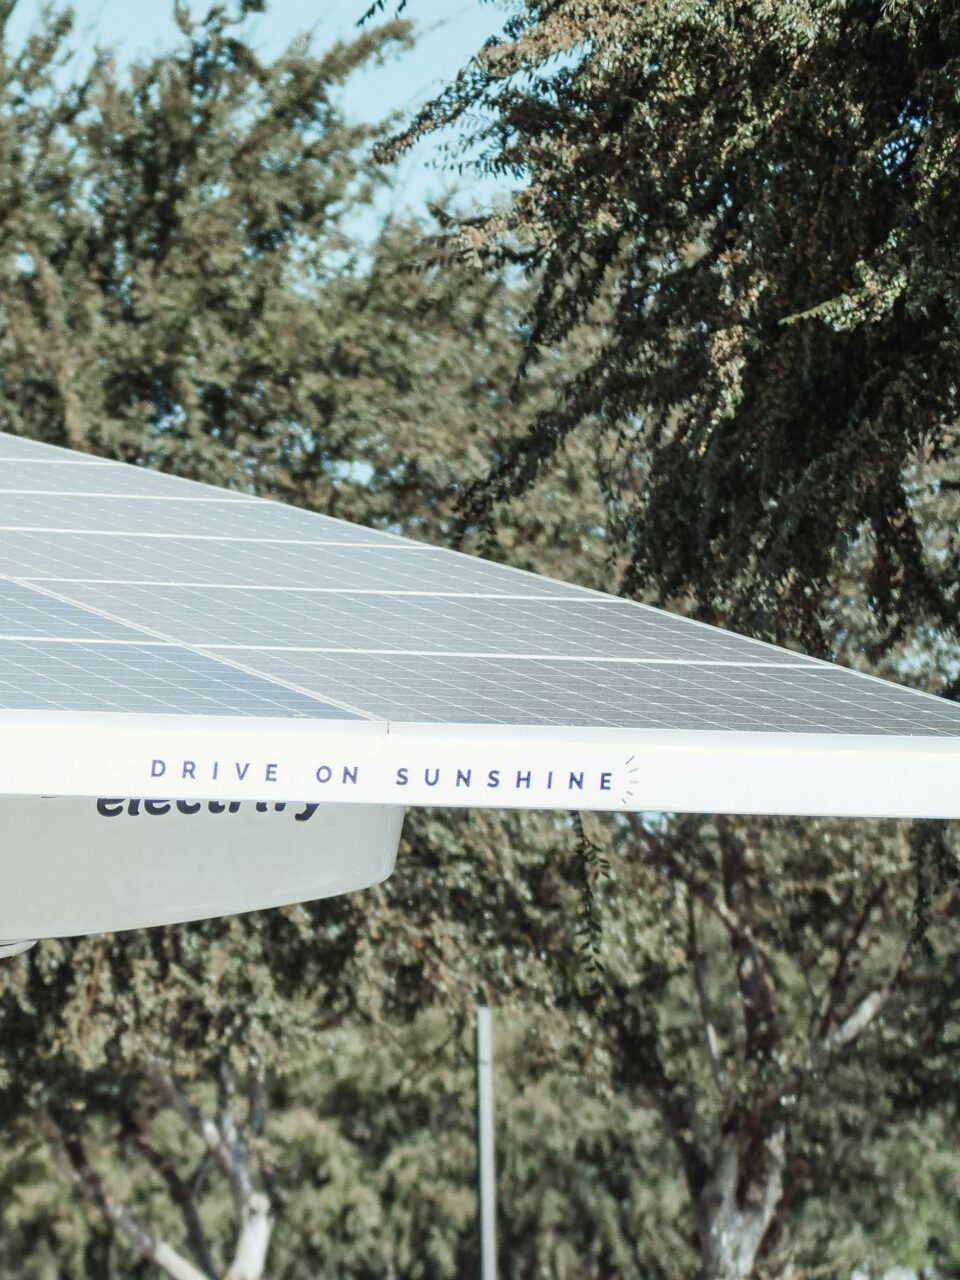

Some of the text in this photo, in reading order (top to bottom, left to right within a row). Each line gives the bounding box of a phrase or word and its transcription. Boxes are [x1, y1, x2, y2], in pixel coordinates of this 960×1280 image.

[150, 759, 613, 791] DRIVE ON SUNSHINE
